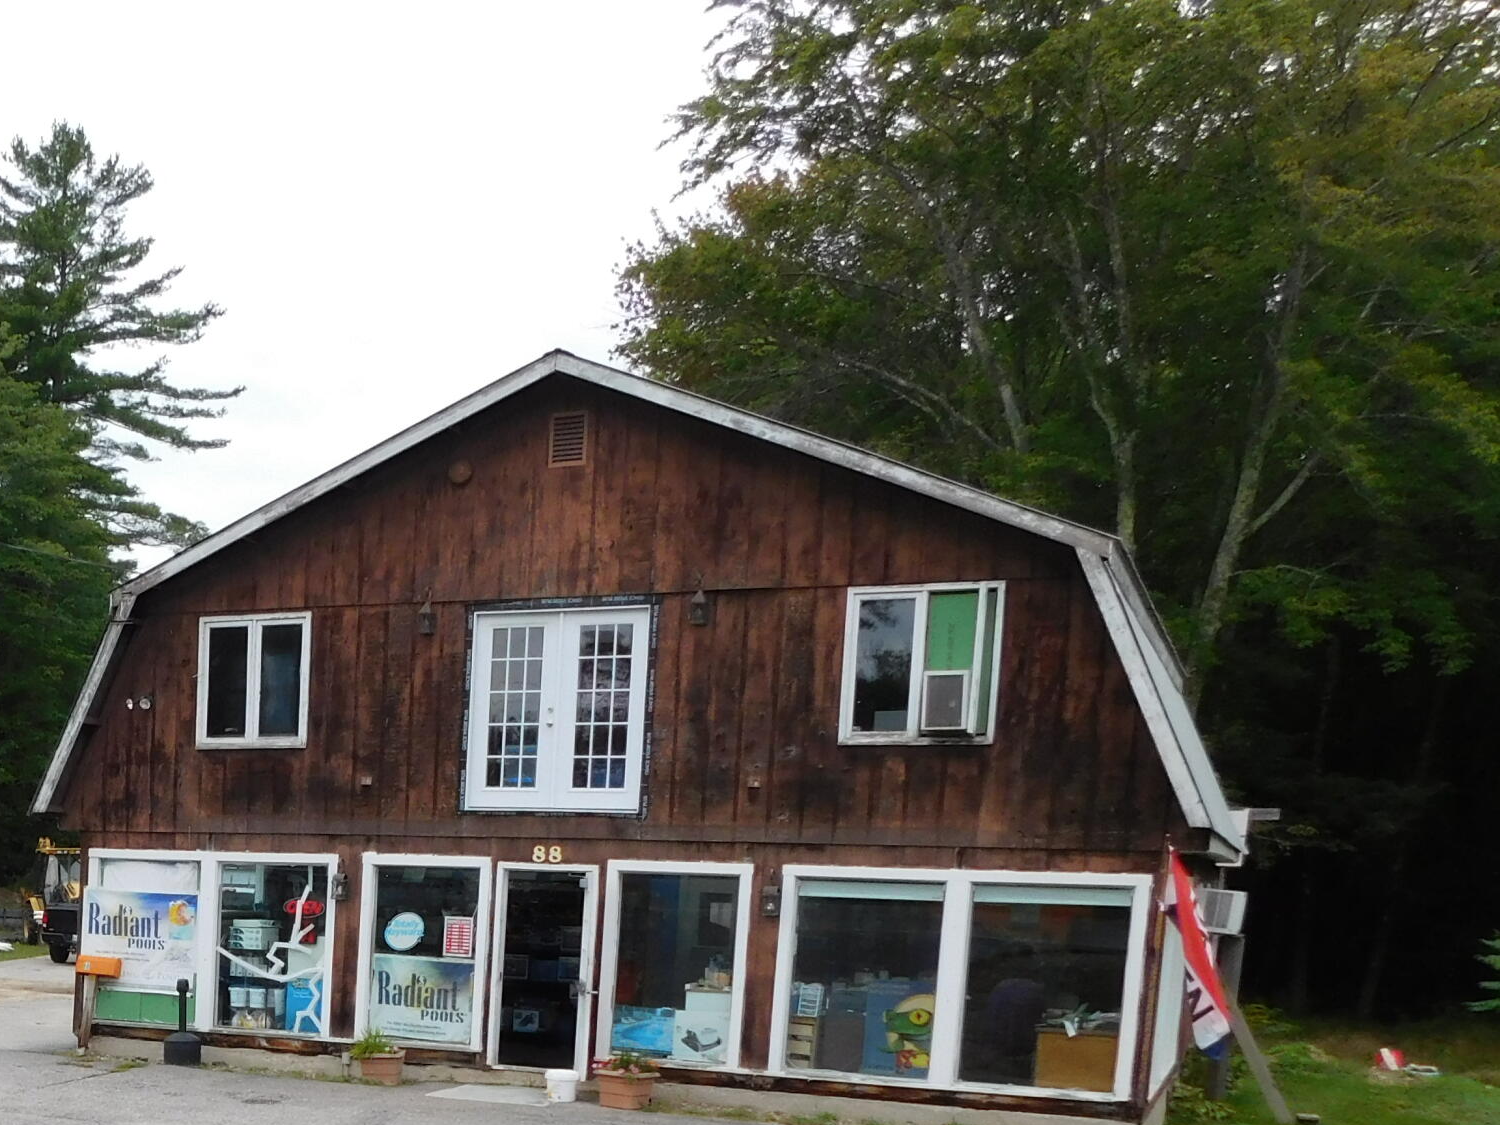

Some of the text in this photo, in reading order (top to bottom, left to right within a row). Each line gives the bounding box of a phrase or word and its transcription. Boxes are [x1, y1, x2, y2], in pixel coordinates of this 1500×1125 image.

[532, 845, 562, 863] 88
[88, 902, 162, 939] Radiant
[127, 938, 165, 950] POOLS
[377, 969, 460, 1011] Radiant
[420, 1009, 464, 1024] POOLS
